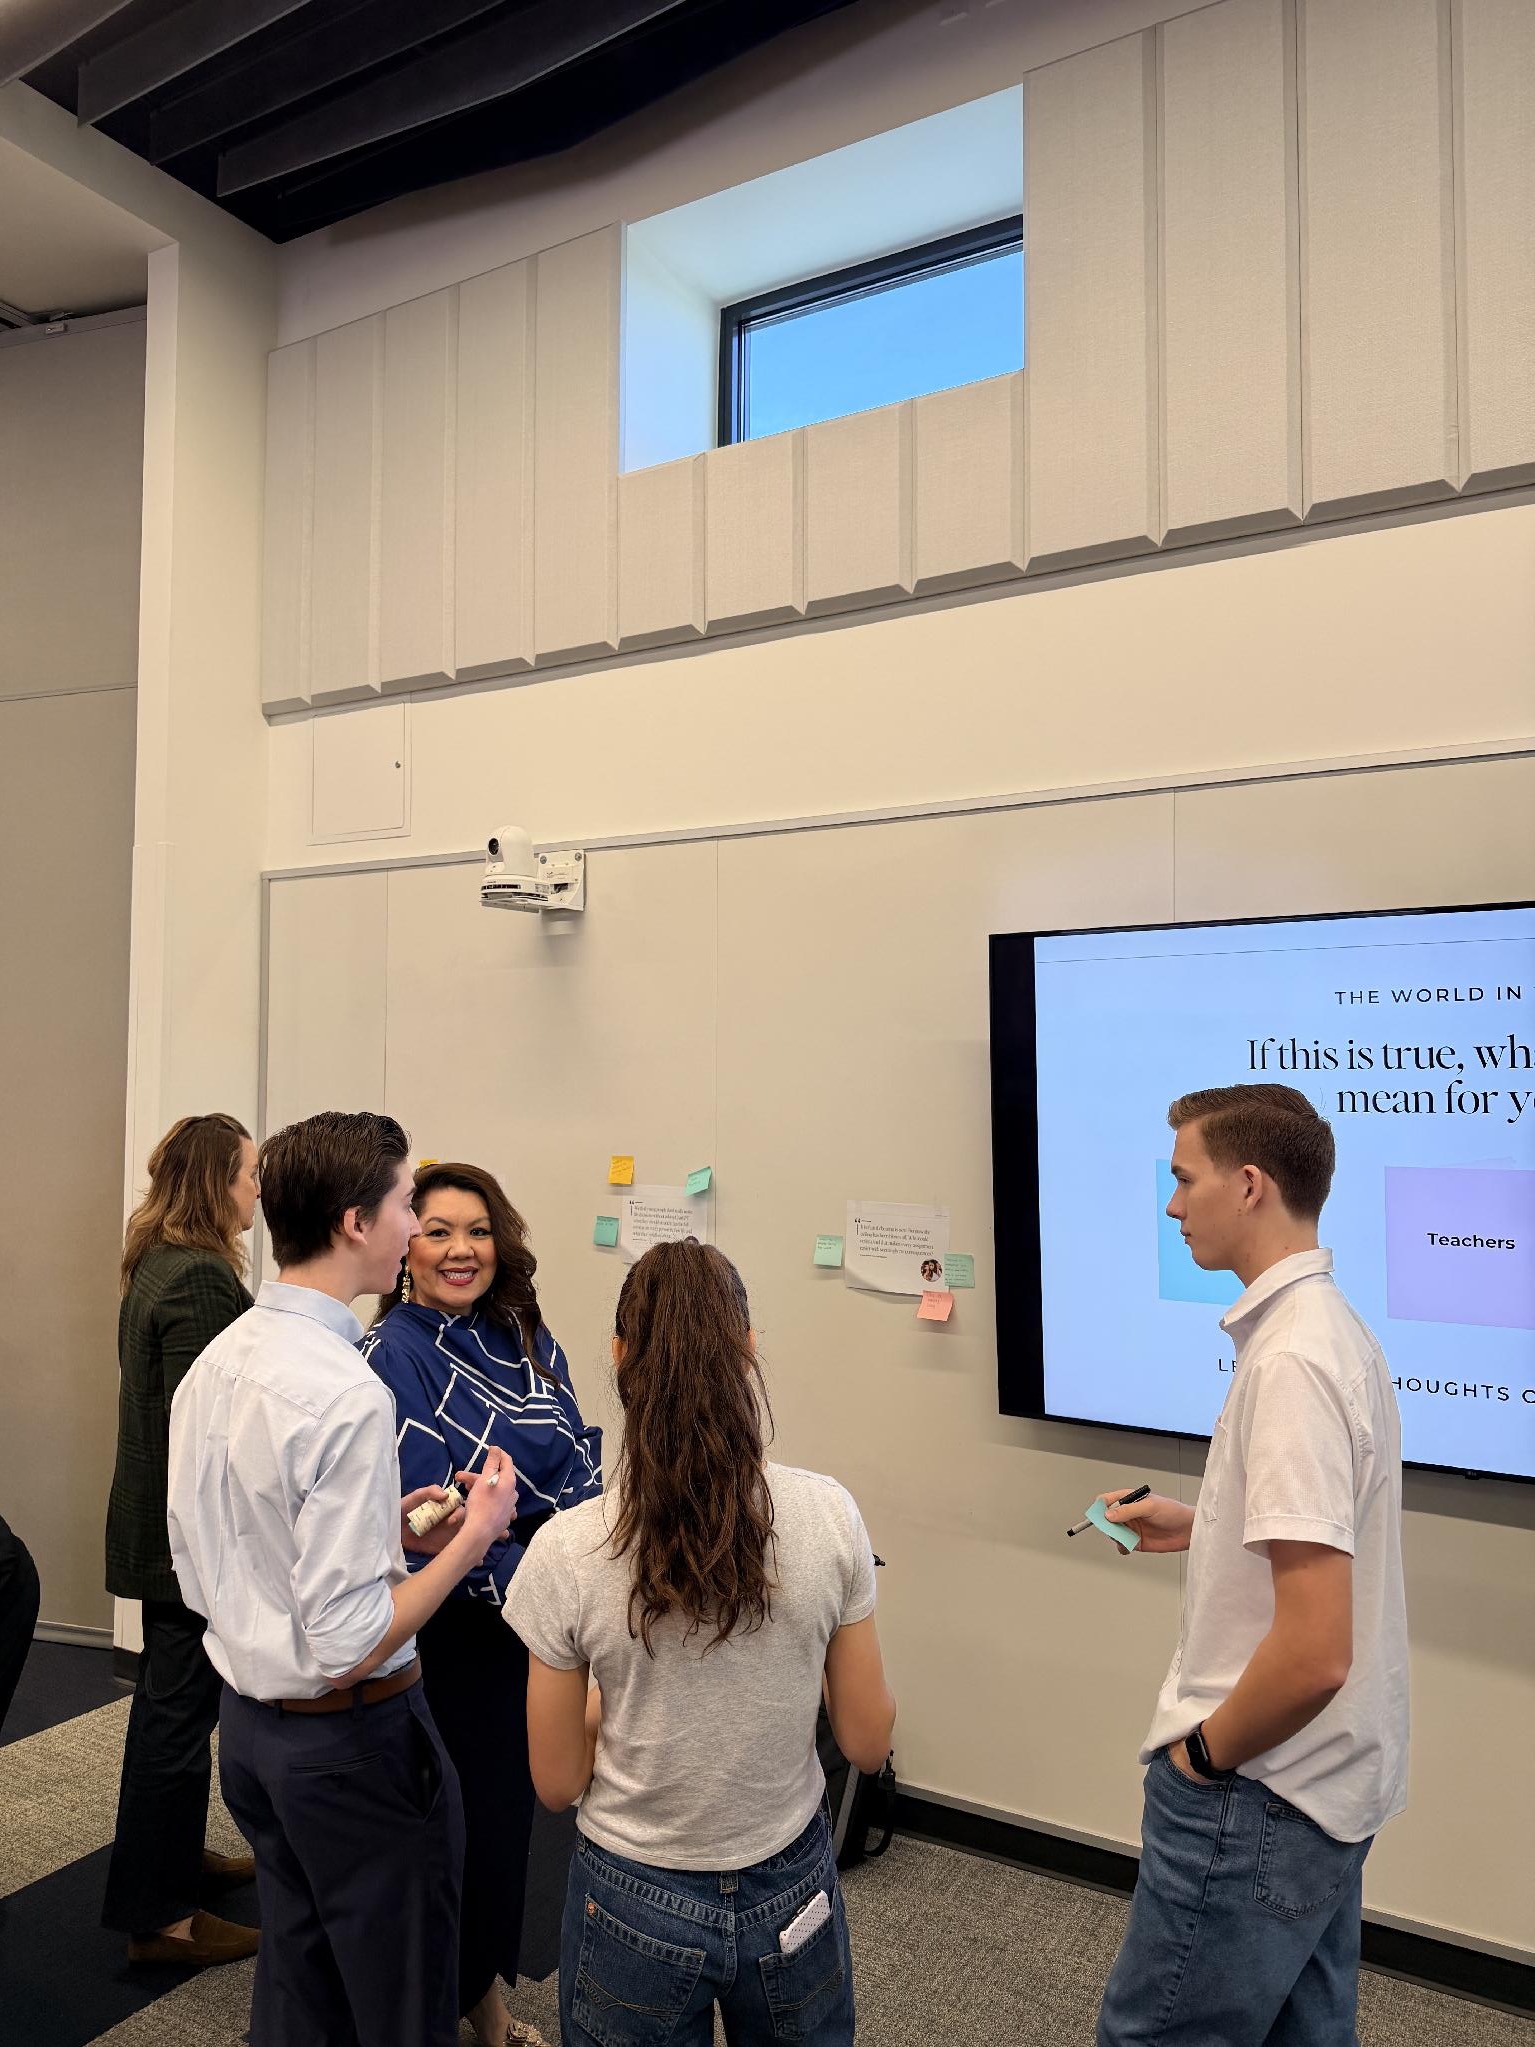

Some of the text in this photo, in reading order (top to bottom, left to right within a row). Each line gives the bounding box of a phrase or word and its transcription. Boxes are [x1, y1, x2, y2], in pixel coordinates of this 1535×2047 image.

[1335, 986, 1521, 1004] THE WORLD IN
[1247, 1034, 1535, 1075] If this is true, wh
[1337, 1091, 1436, 1113] mean
[1445, 1080, 1498, 1114] for
[1427, 1233, 1515, 1249] Teachers
